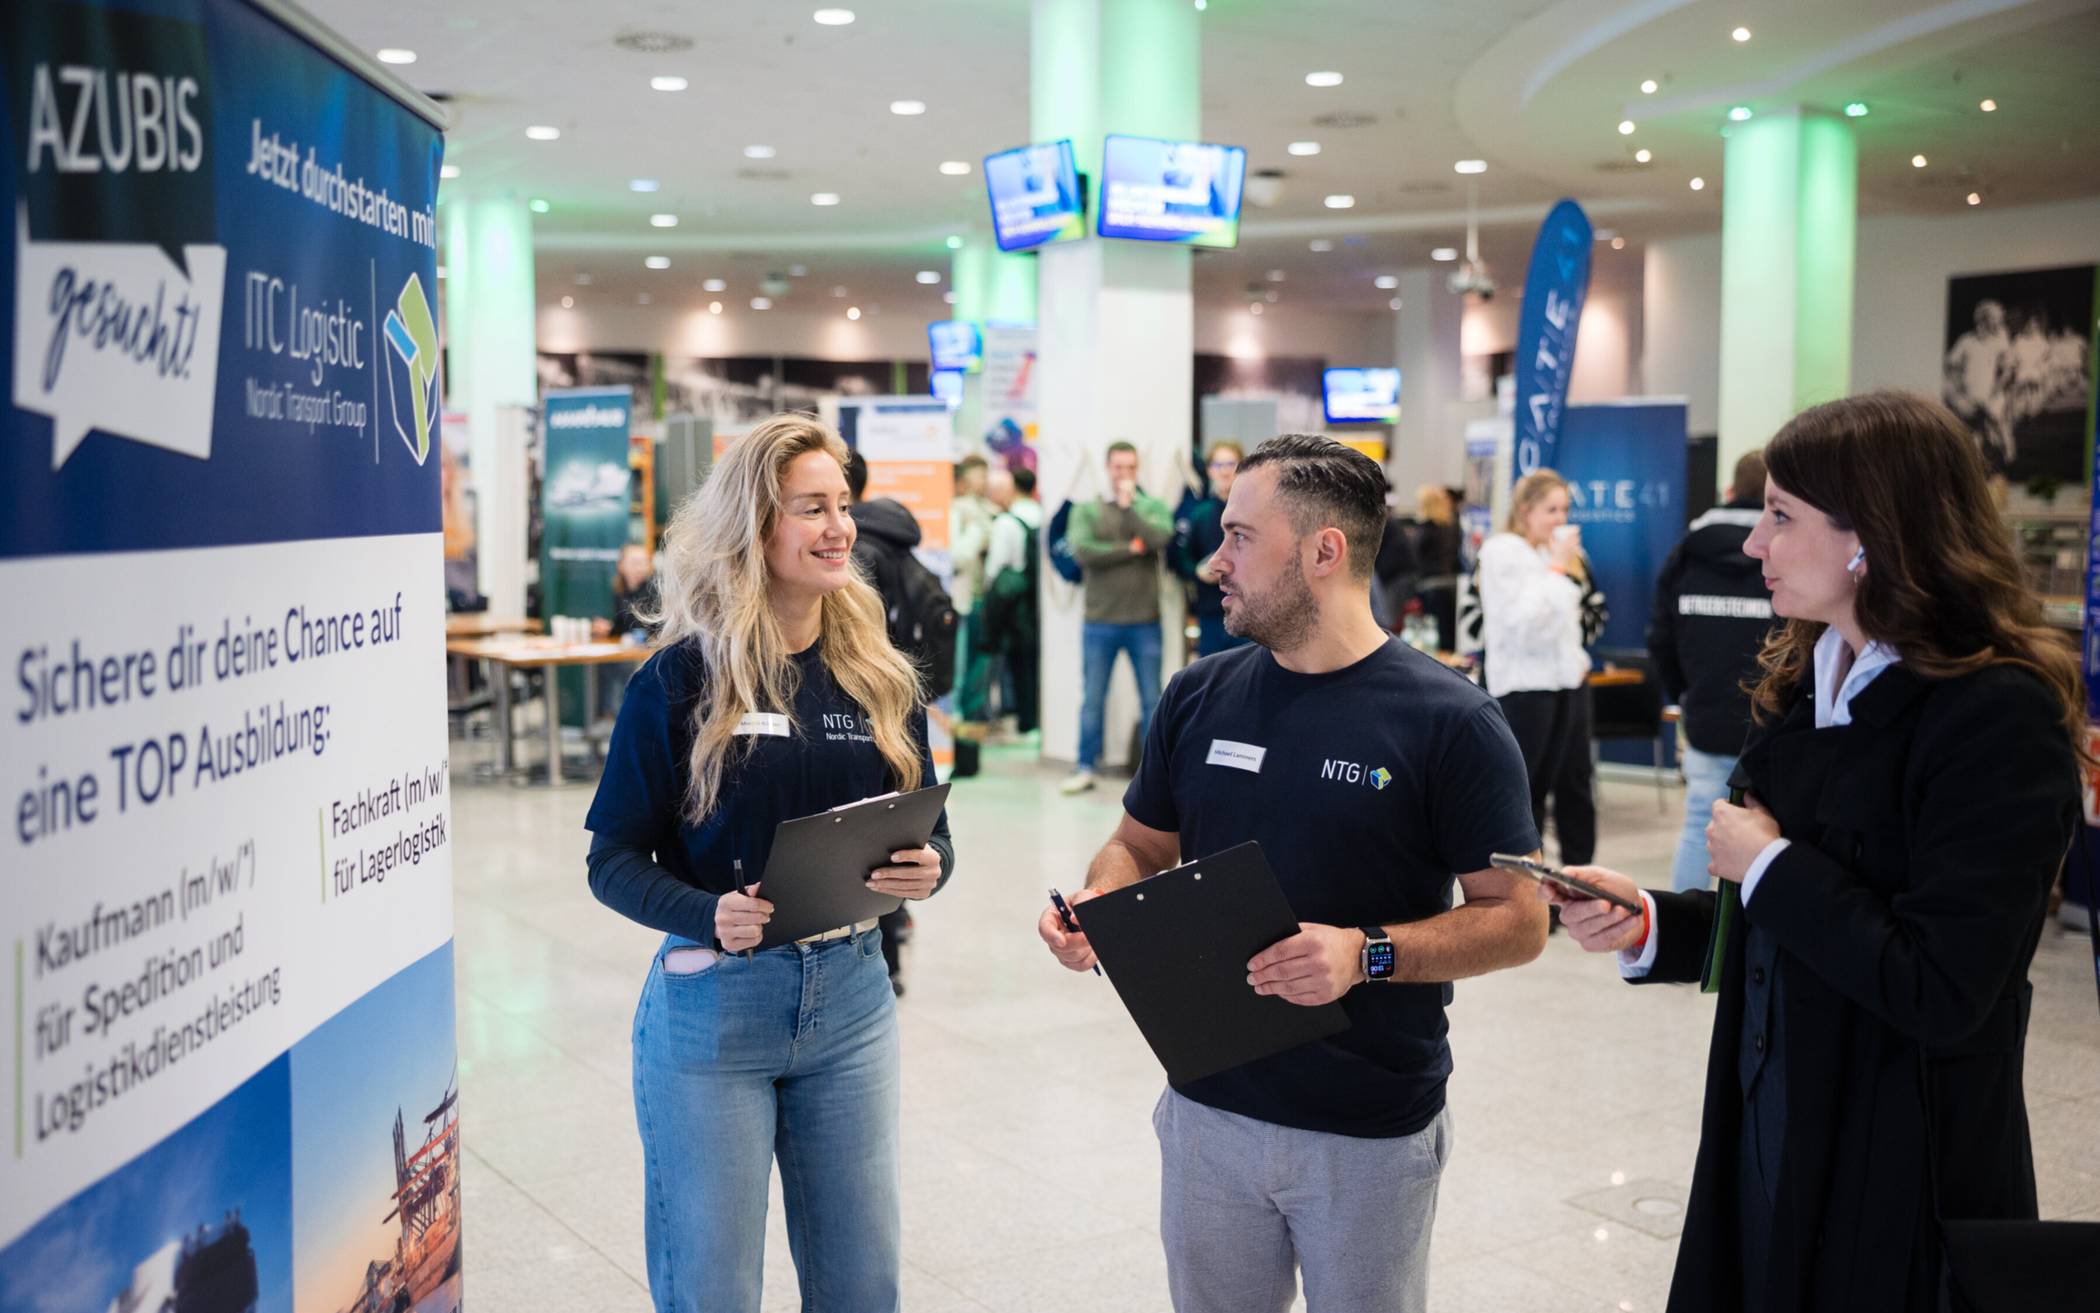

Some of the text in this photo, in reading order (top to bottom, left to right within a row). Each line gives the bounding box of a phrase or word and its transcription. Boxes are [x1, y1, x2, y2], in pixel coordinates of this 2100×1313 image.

[26, 62, 203, 173] AZUBIS
[247, 118, 301, 192] Jetzt
[302, 150, 409, 239] durchstarten
[43, 265, 201, 394] gesucht!
[245, 271, 365, 387] ITC Logistic
[245, 376, 367, 438] Nordic Transport Group
[17, 592, 402, 725] Sichere dir deine Chance auf
[16, 701, 331, 846] eine TOP Ausbildung:
[823, 713, 854, 730] NTG
[826, 732, 847, 741] Nordic
[1320, 758, 1361, 784] NTG
[332, 779, 401, 838] Fachkraft
[333, 812, 448, 897] für Lagerlogistik
[35, 901, 175, 981] Kaufmann
[35, 910, 244, 1061] für Spedition und
[36, 966, 281, 1142] Logistikdienstleistung
